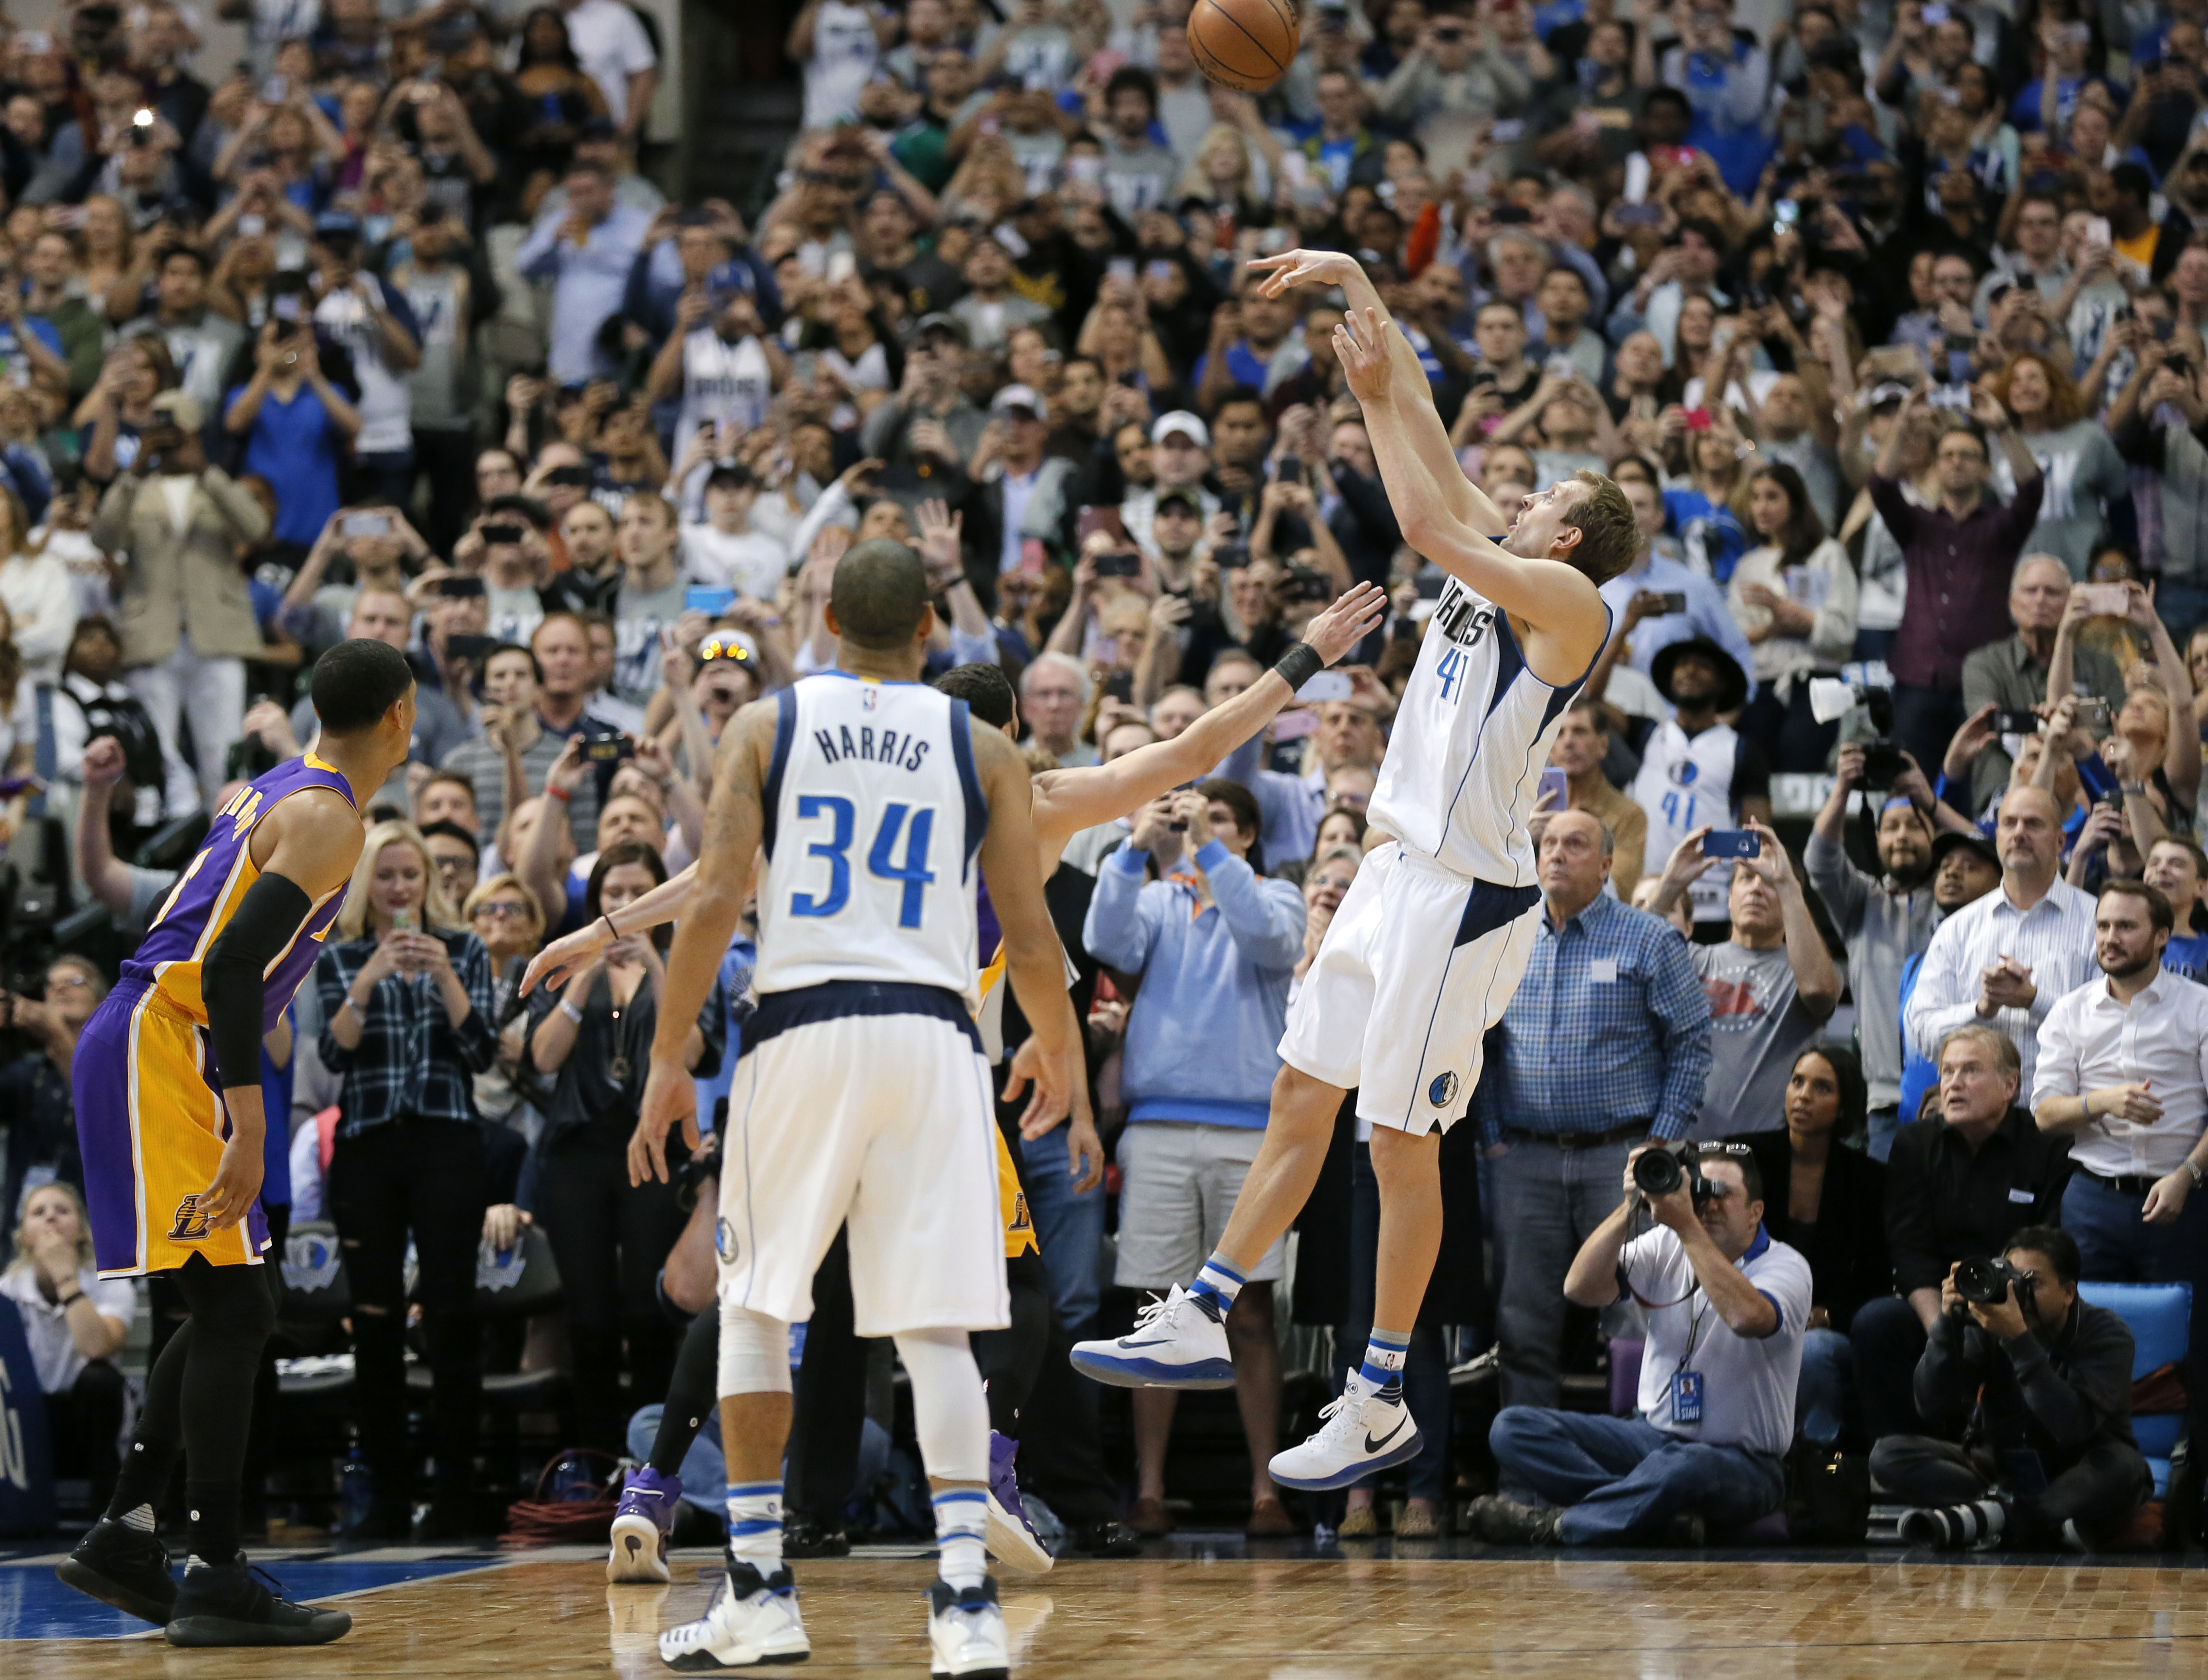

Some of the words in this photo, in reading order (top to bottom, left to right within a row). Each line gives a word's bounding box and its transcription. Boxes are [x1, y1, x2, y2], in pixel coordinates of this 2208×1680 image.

[1437, 648, 1469, 706] 41
[814, 724, 929, 772] HARRIS
[1662, 791, 1697, 830] 41
[789, 793, 936, 929] 34
[1681, 1404, 1700, 1420] STAFF
